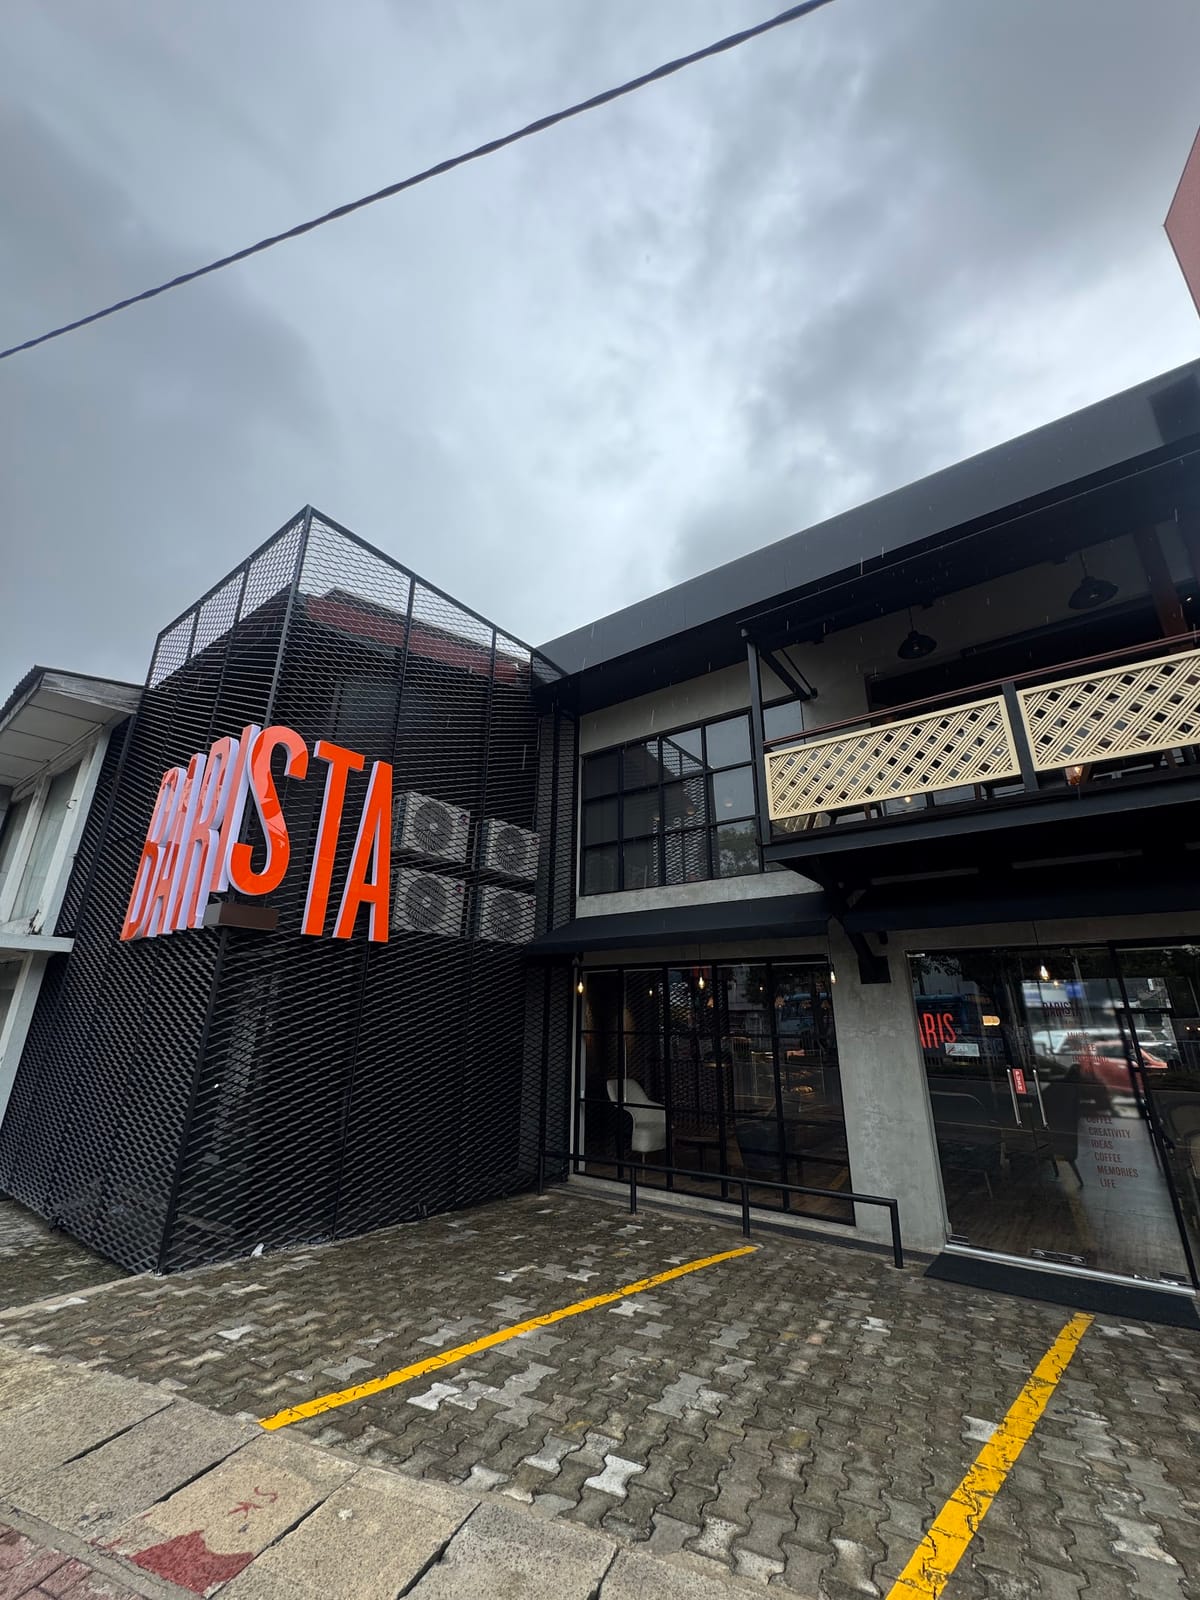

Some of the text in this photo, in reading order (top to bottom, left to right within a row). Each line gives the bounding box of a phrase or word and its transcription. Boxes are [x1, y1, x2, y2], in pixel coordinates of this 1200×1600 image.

[120, 724, 393, 943] BARISTA
[1088, 1127, 1131, 1139] CREATIVITY
[1090, 1139, 1114, 1150] IDEAS
[1094, 1152, 1122, 1163] COFFEE
[1097, 1166, 1139, 1178] MEMORIES
[1100, 1178, 1118, 1189] LIFE
